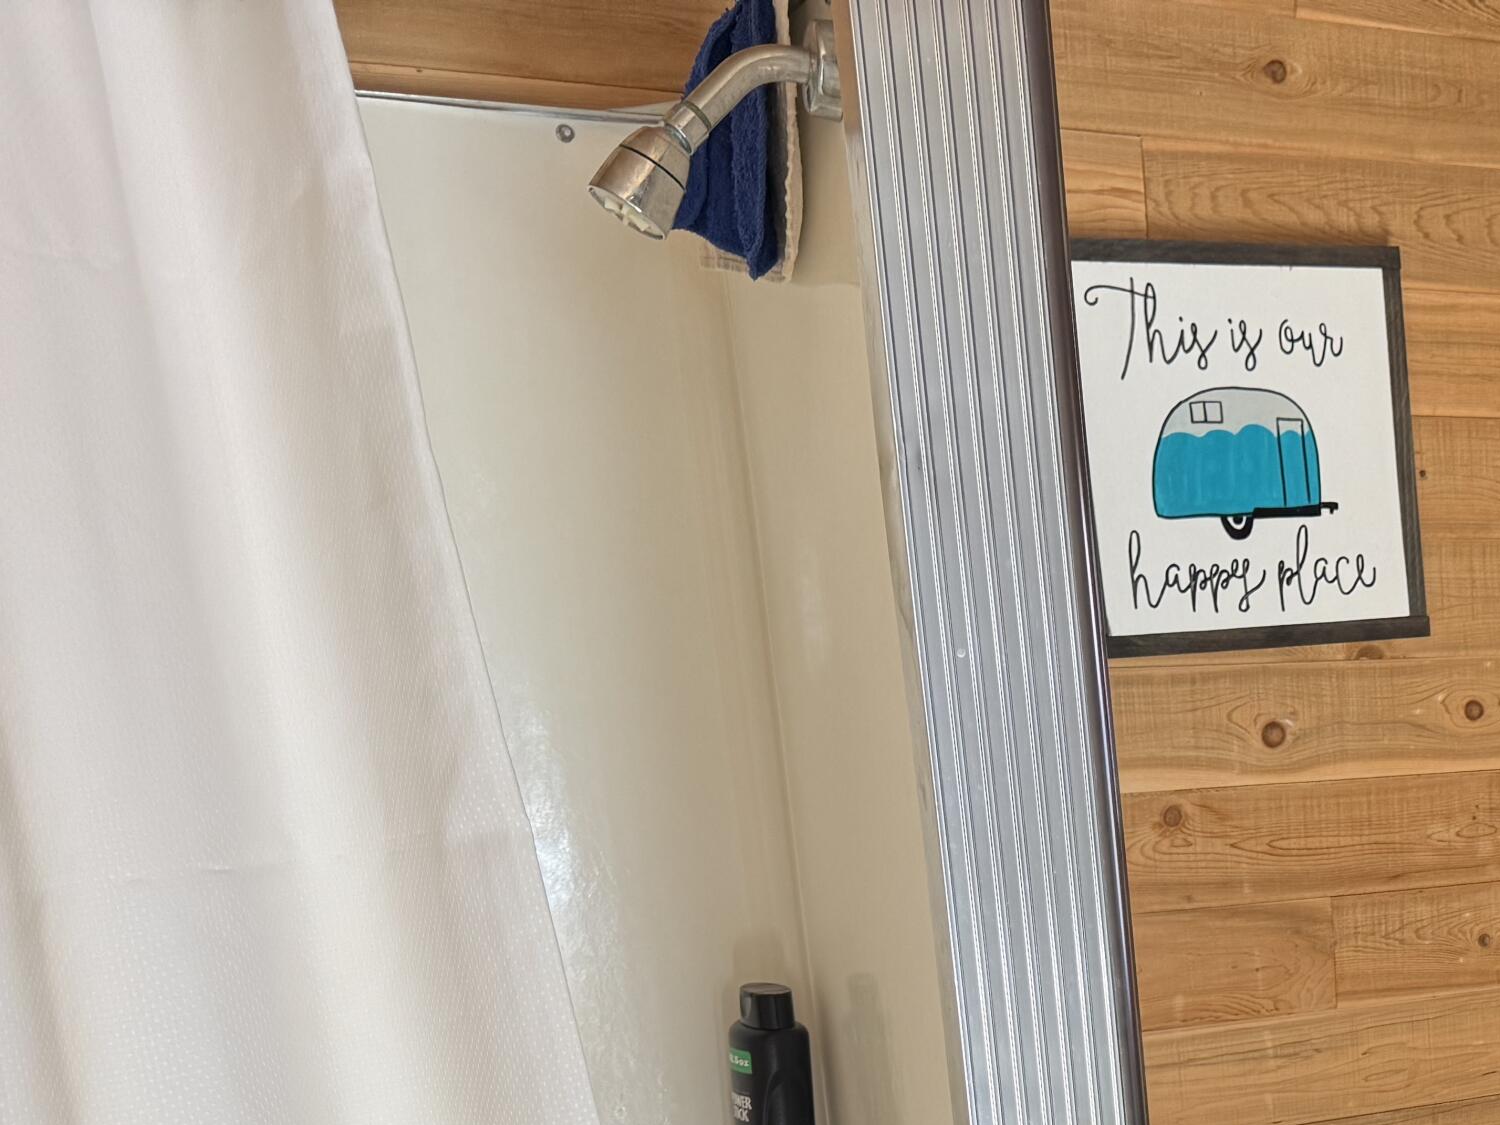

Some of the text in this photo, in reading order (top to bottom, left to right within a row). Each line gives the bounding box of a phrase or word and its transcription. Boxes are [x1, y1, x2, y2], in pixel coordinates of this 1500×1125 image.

[1084, 277, 1343, 380] This is our
[1128, 524, 1376, 612] happy place
